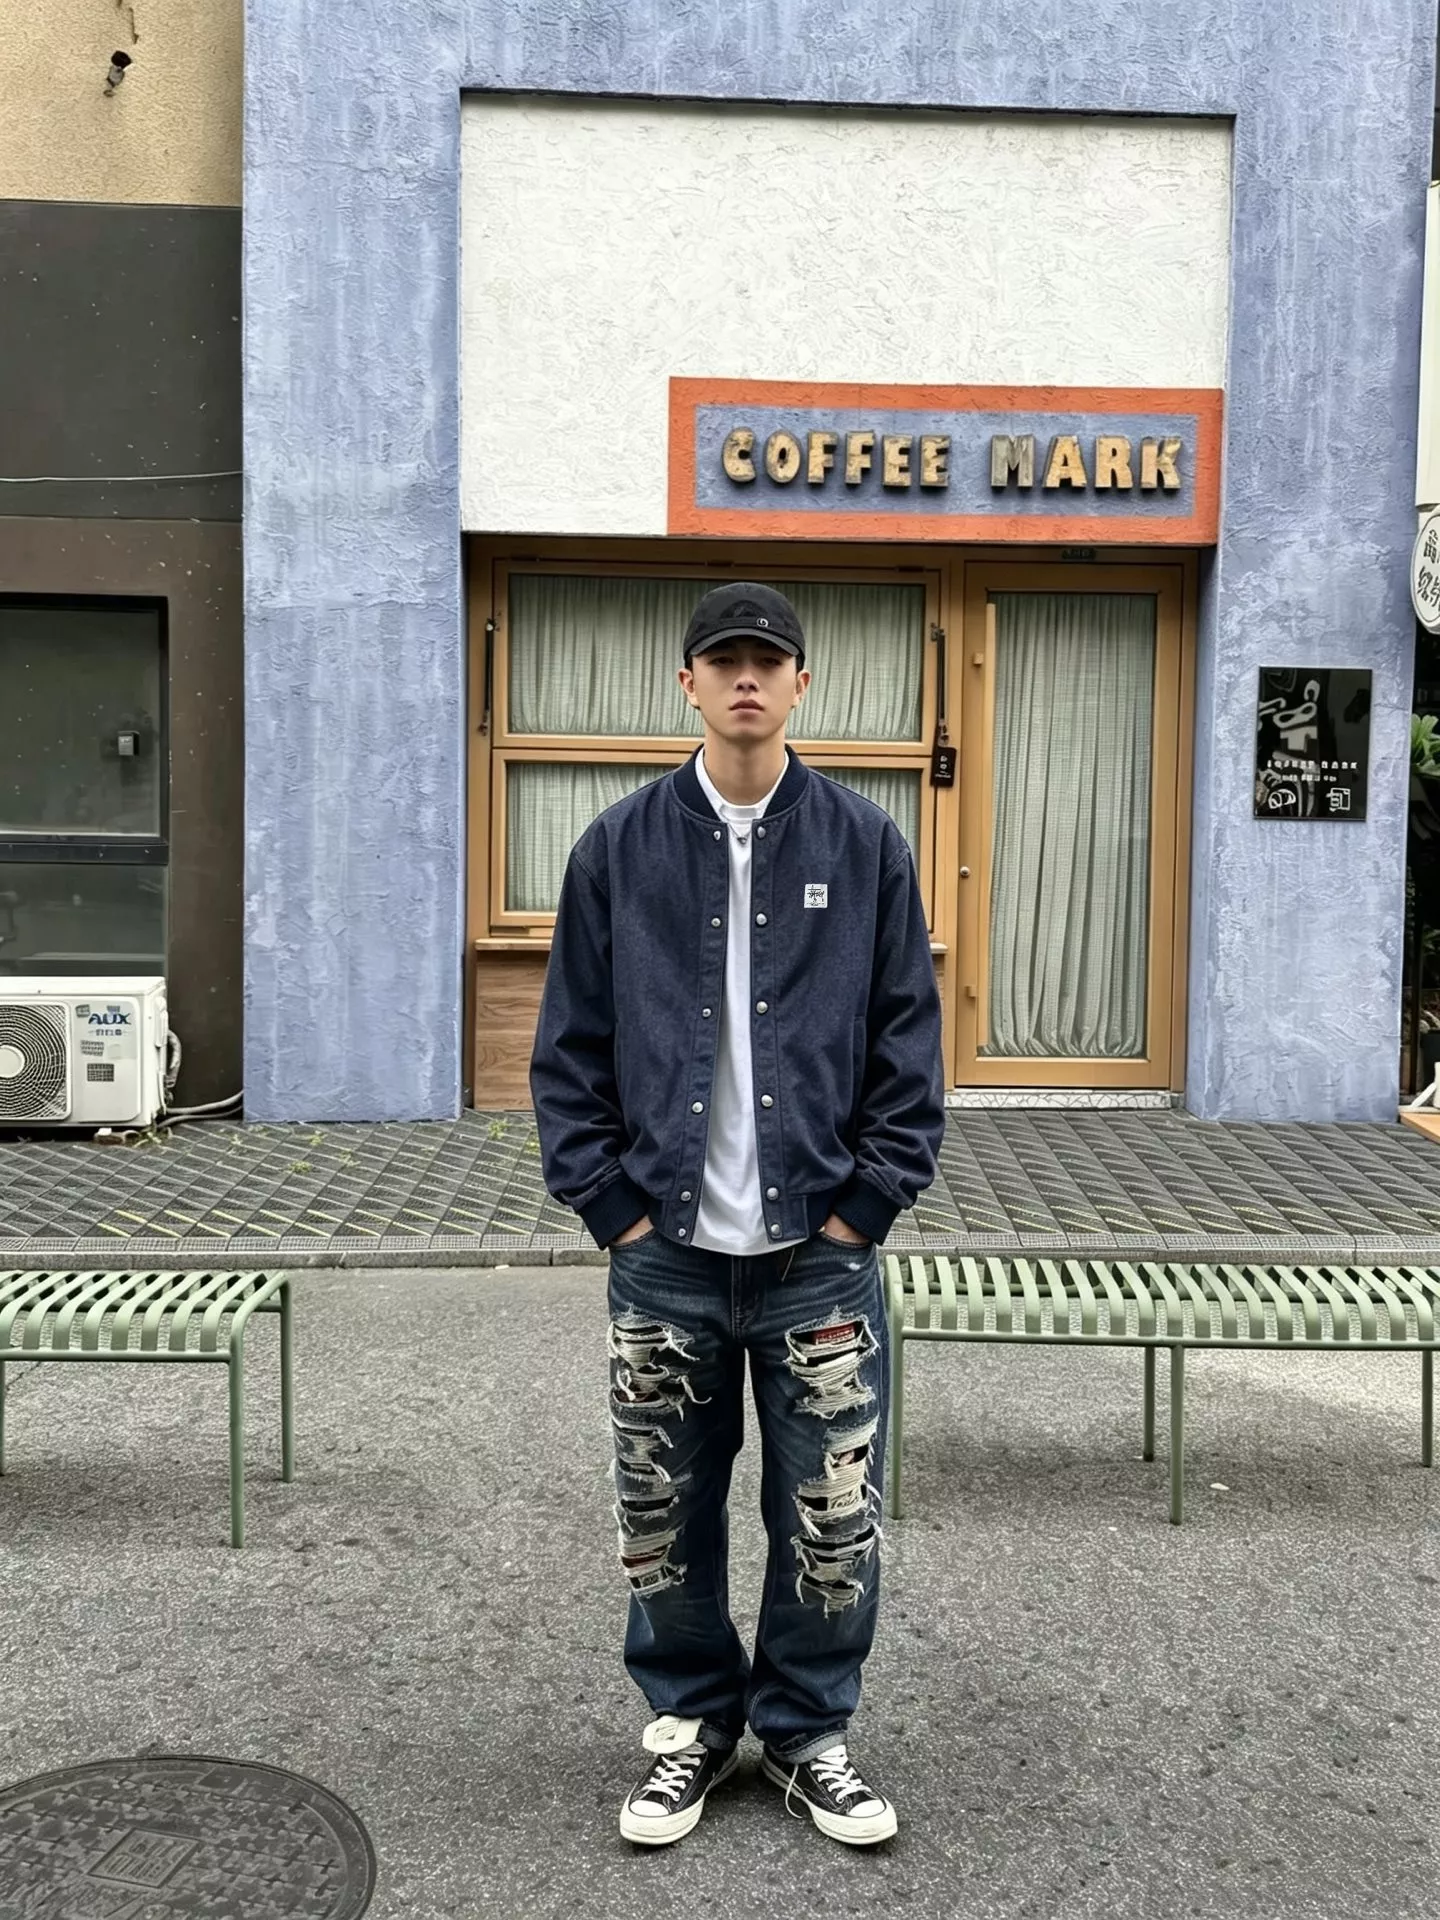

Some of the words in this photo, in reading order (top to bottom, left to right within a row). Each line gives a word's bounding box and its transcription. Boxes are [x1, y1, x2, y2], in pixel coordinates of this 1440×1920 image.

[721, 426, 950, 488] COFFEE
[991, 434, 1181, 489] MARK
[88, 1013, 131, 1025] AUX
